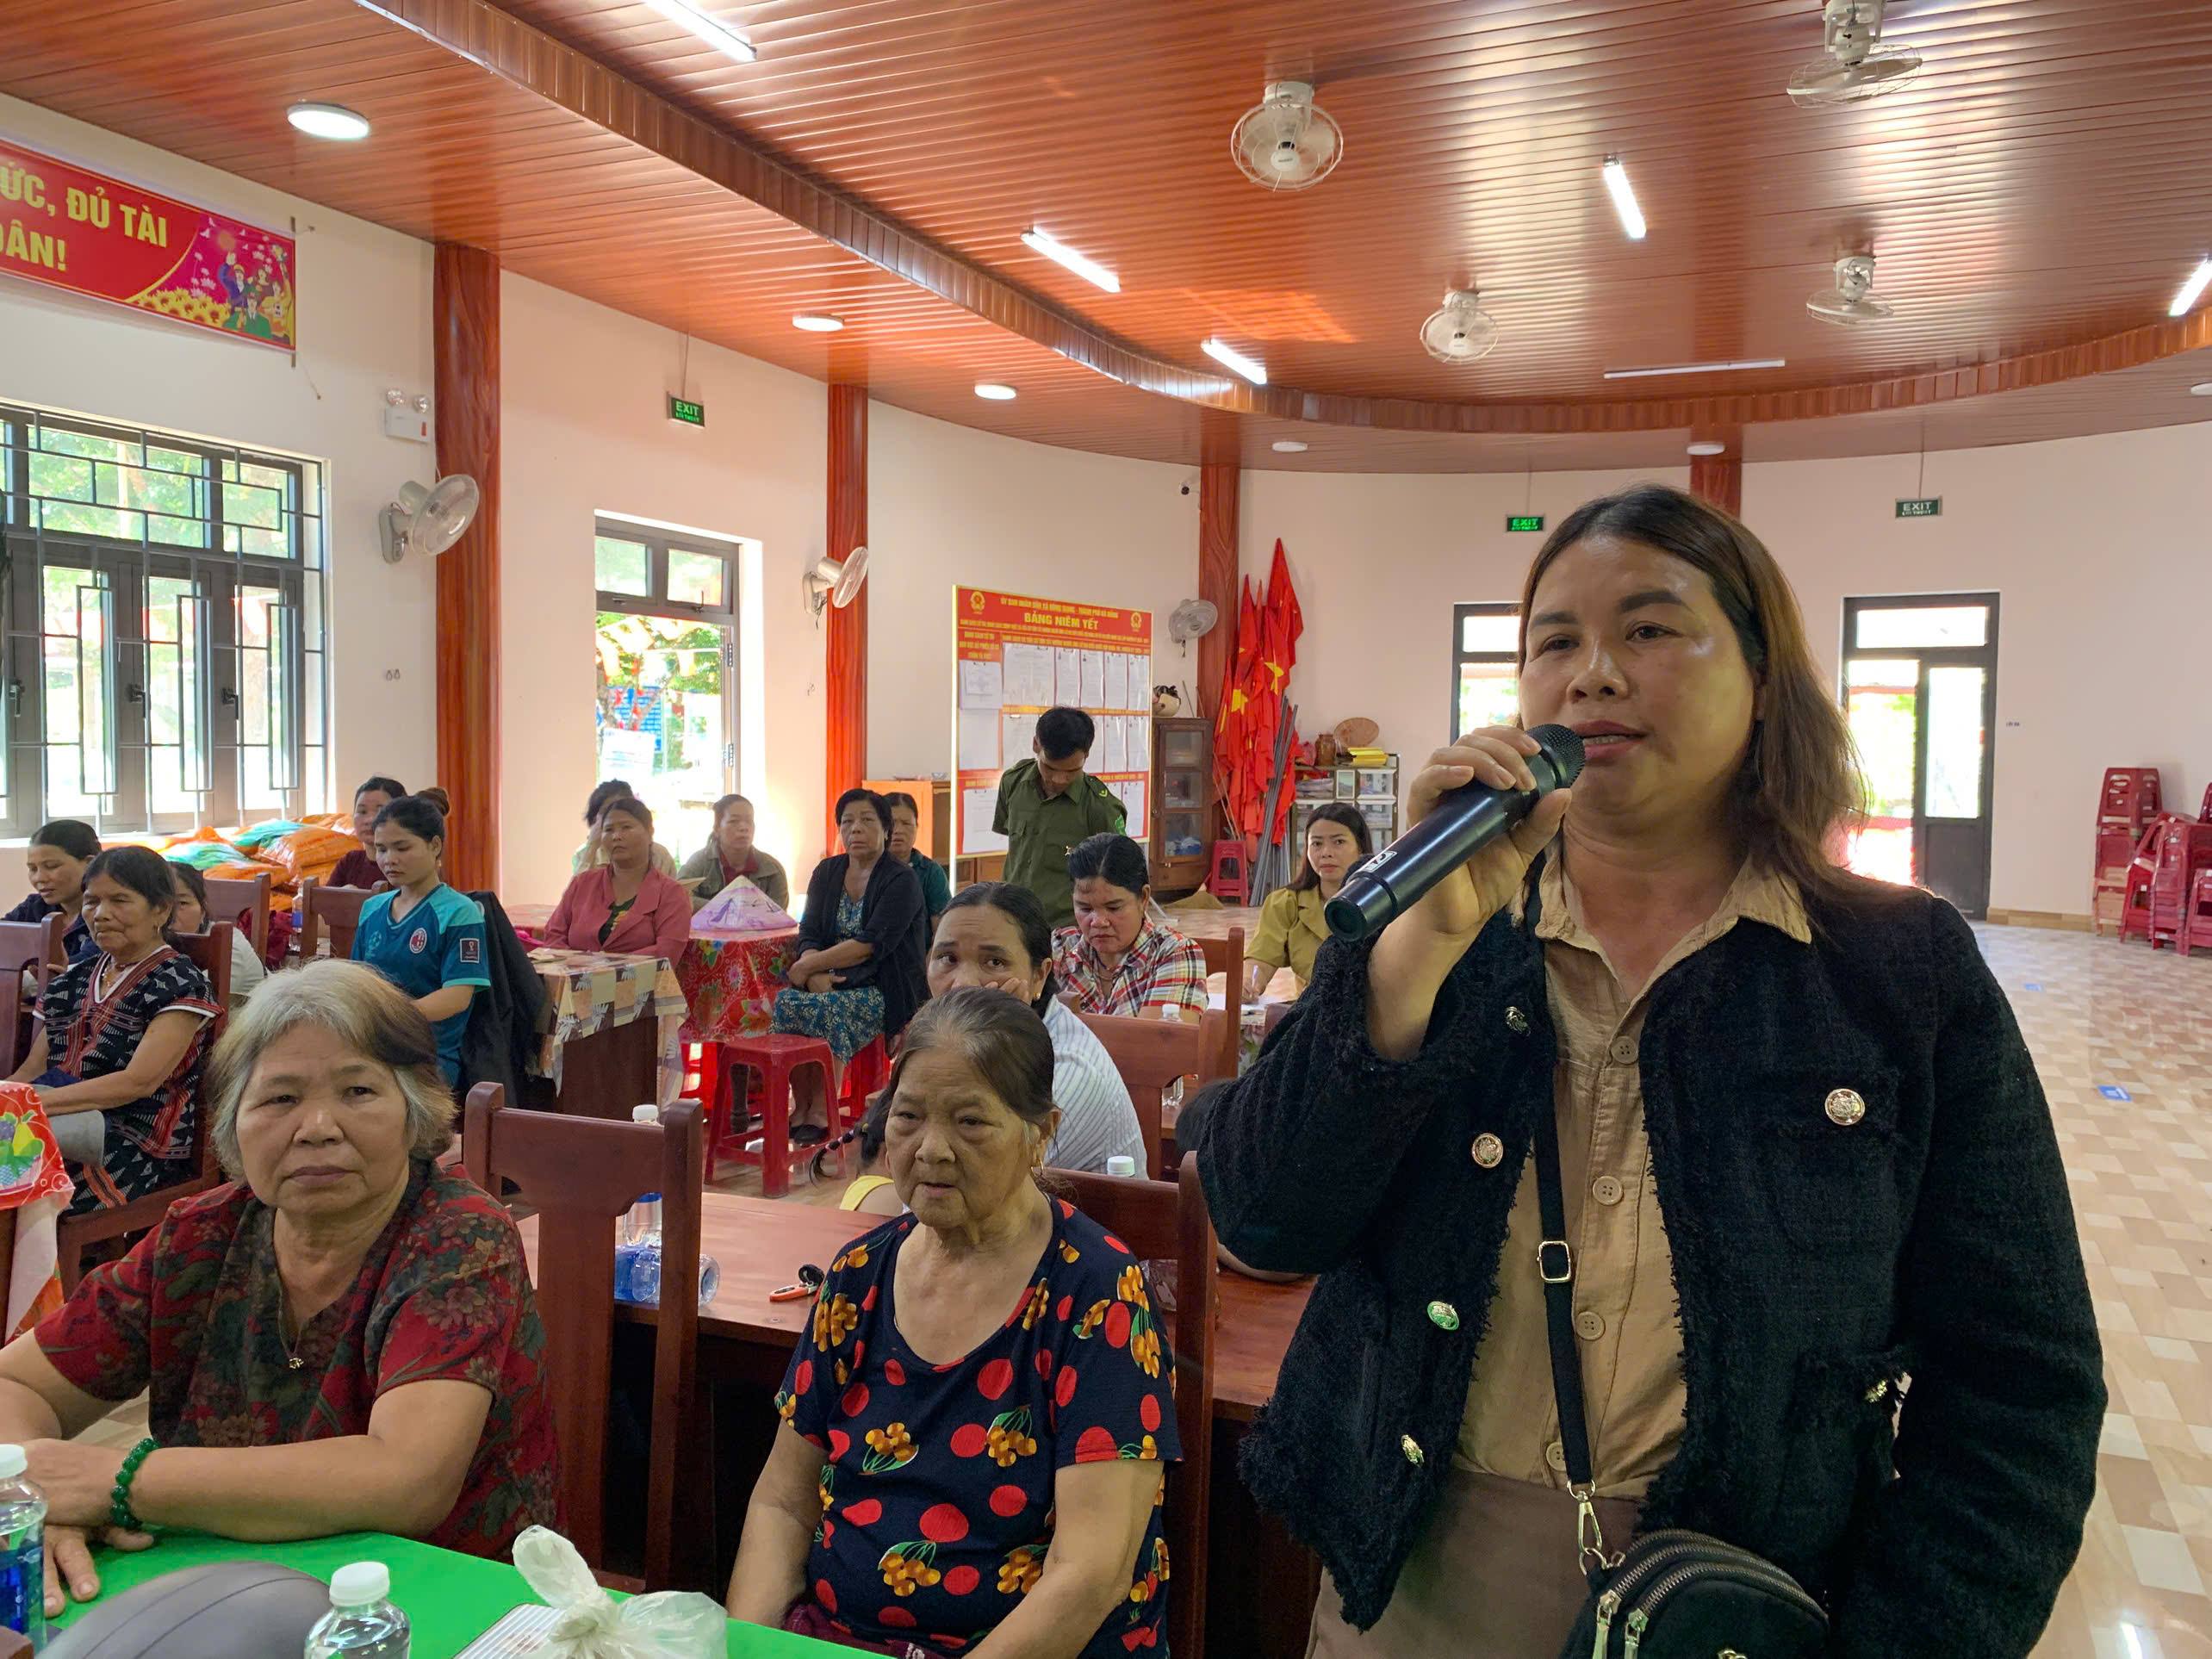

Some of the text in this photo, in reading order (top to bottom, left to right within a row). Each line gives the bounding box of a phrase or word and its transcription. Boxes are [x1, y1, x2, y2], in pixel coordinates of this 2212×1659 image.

[66, 186, 109, 229] ĐỦ
[119, 203, 167, 248] TÀI
[0, 219, 66, 271] ÂN!
[676, 401, 699, 416] EXIT
[1903, 501, 1932, 511] EXIT
[1513, 518, 1538, 526] EXIT
[1024, 610, 1099, 631] BẢNG NIÊM YẾT
